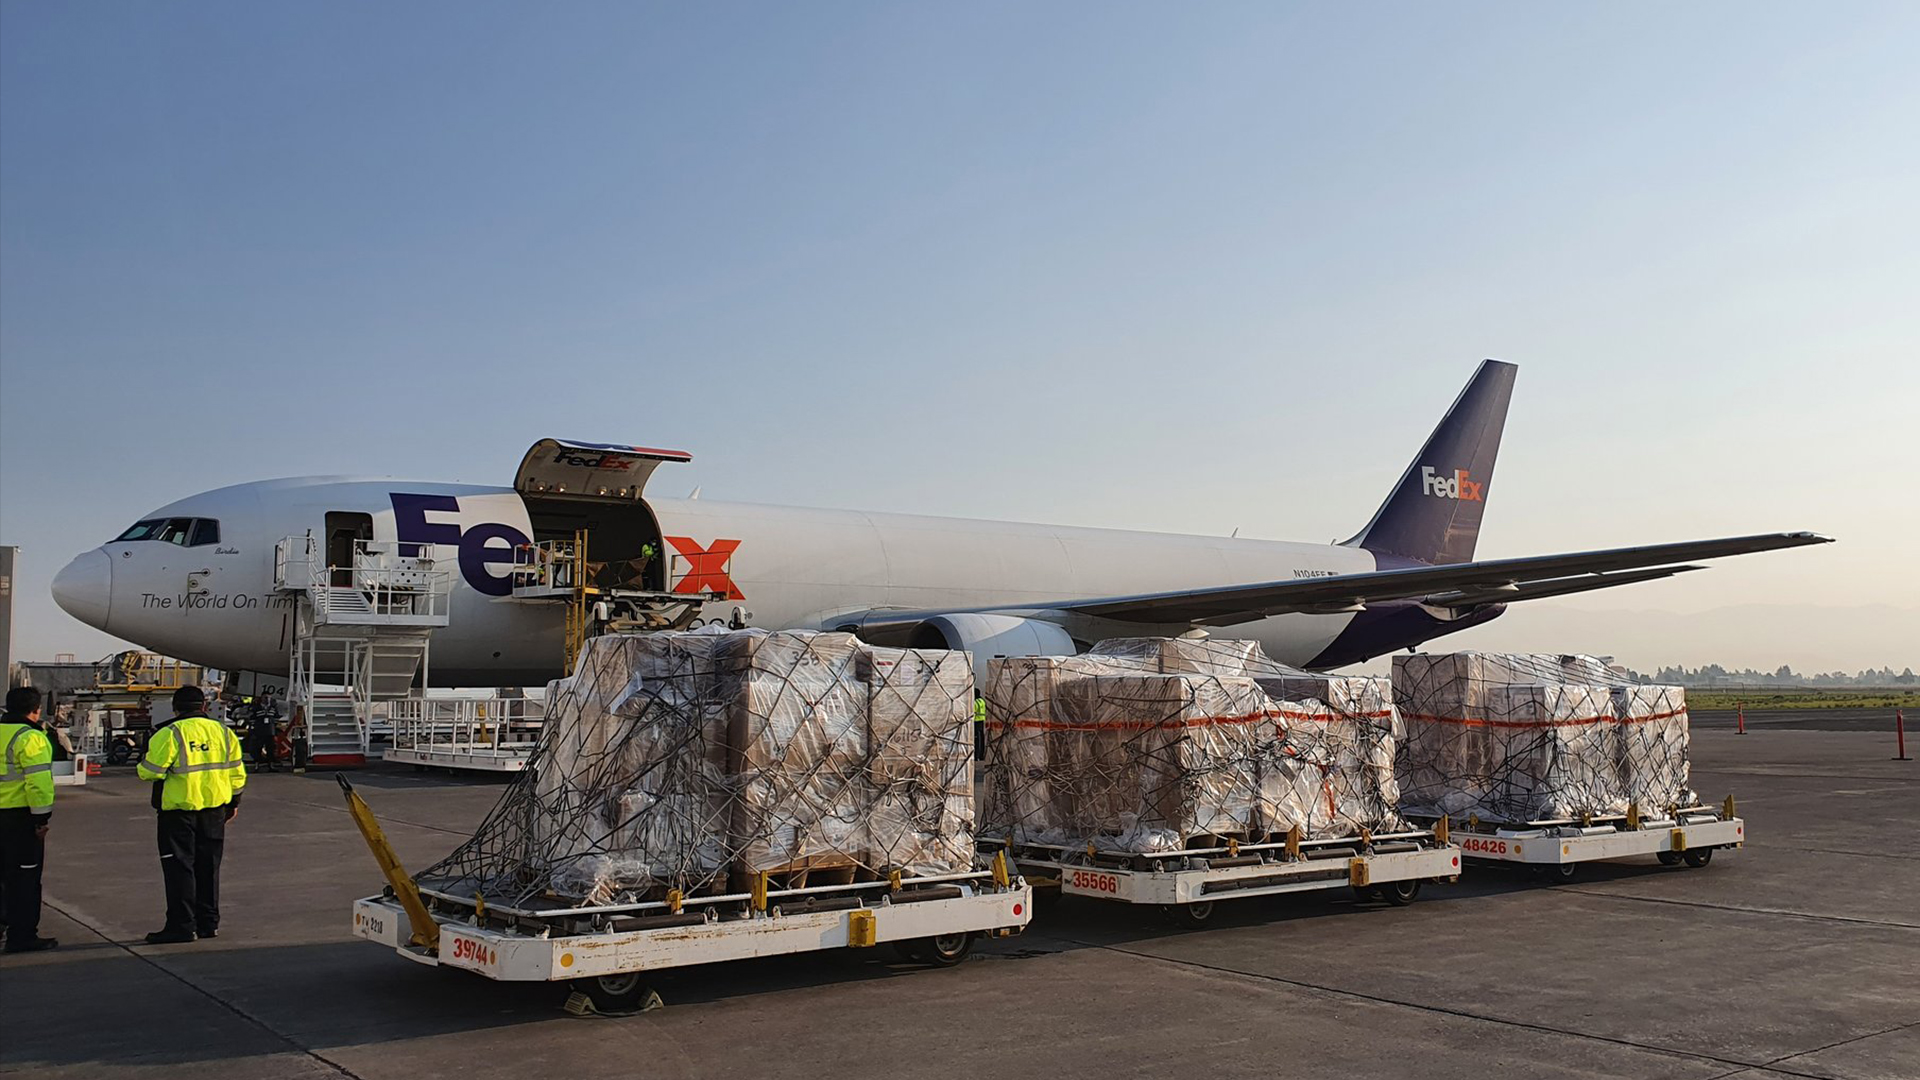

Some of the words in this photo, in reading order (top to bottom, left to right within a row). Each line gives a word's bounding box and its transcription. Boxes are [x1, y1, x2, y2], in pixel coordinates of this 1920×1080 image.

[1421, 466, 1482, 501] FedEx
[142, 593, 171, 609] The
[177, 593, 227, 609] World
[233, 593, 257, 609] On
[264, 594, 294, 609] Tim
[262, 684, 285, 696] 104
[1463, 838, 1507, 854] 48426
[1073, 871, 1117, 894] 35566
[453, 937, 488, 966] 39744
